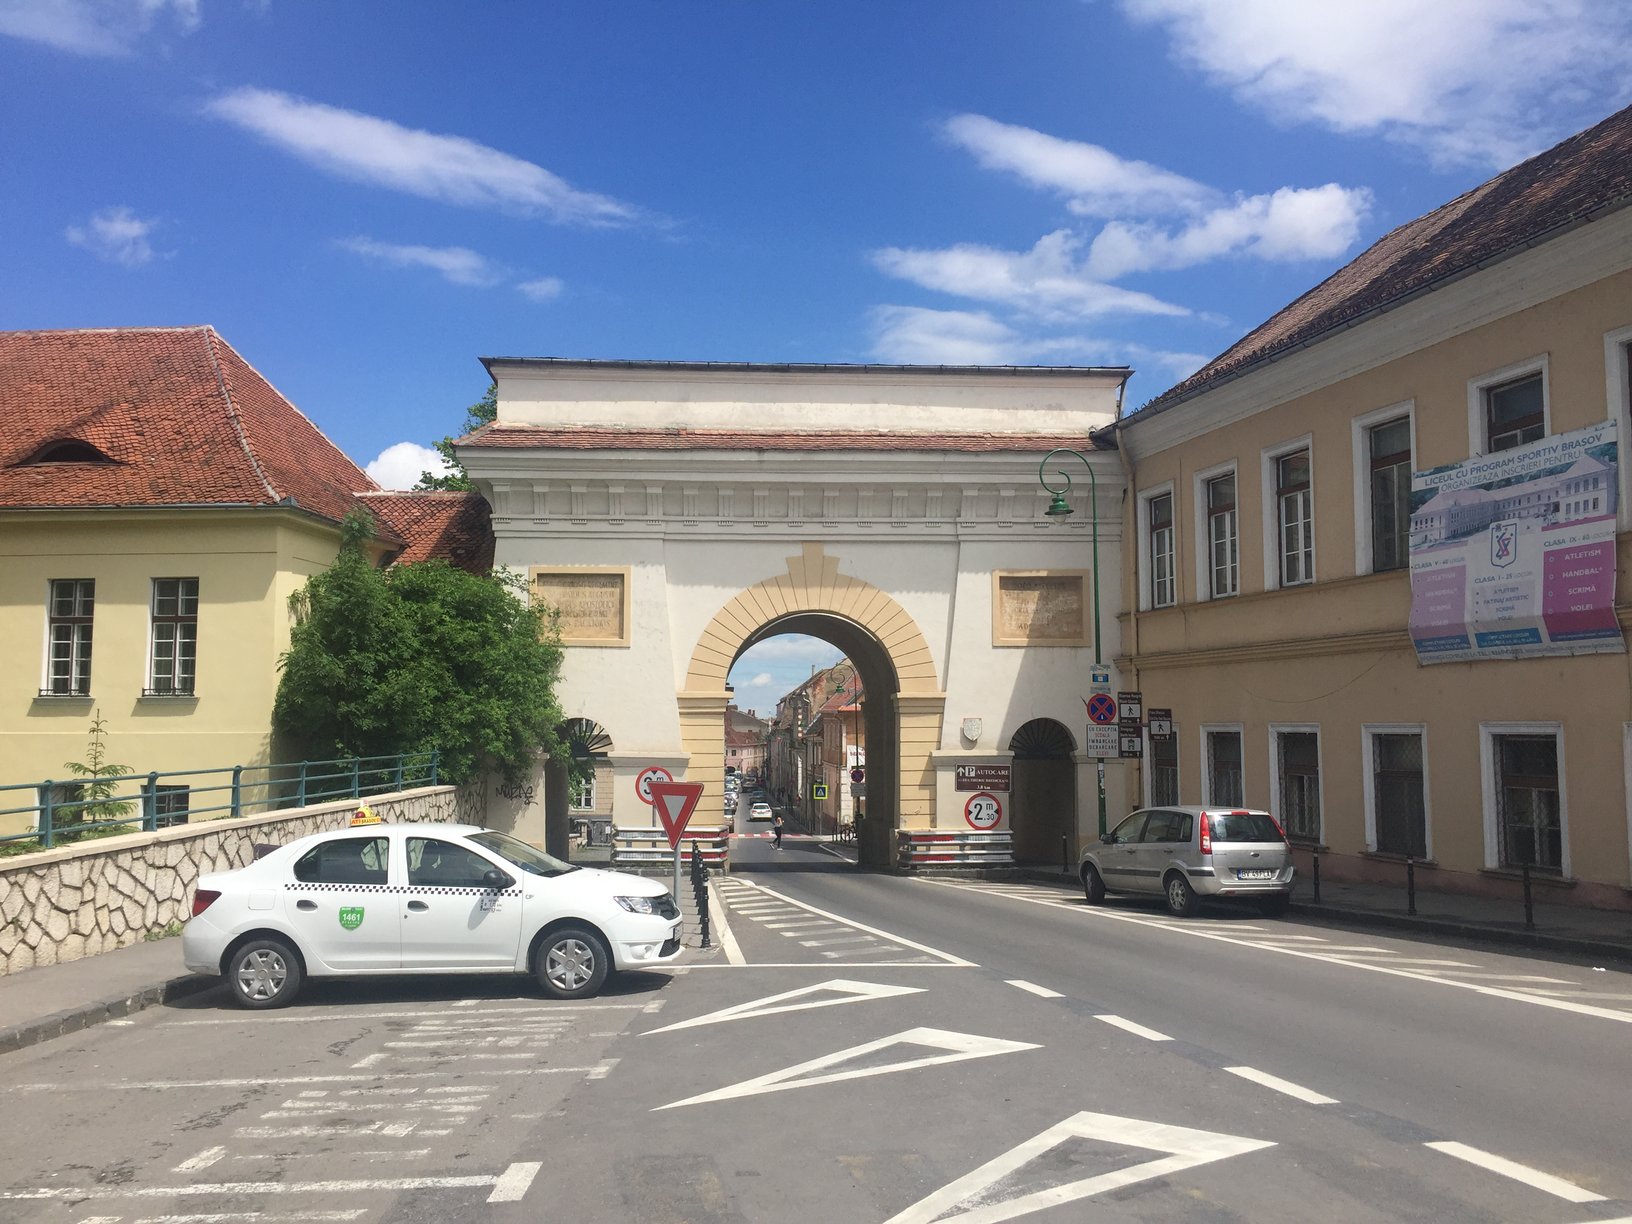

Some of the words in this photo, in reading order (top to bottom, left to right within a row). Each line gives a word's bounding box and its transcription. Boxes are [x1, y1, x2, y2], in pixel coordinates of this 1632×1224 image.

[1424, 473, 1454, 487] LICEUL
[1455, 469, 1469, 480] CU
[1470, 456, 1515, 476] PROGRAM
[1517, 445, 1559, 467] SPORTIV
[1561, 433, 1603, 452] BRASOV
[1440, 471, 1500, 492] ORGANIZEAZA
[1501, 460, 1542, 478] INSCRIERI
[1543, 538, 1566, 547] CLASA
[1564, 549, 1601, 561] ATLETISM
[1414, 562, 1432, 570] CLASA
[1474, 575, 1496, 584] CLASA
[1570, 603, 1593, 612] VOLEI
[342, 913, 361, 921] 1461
